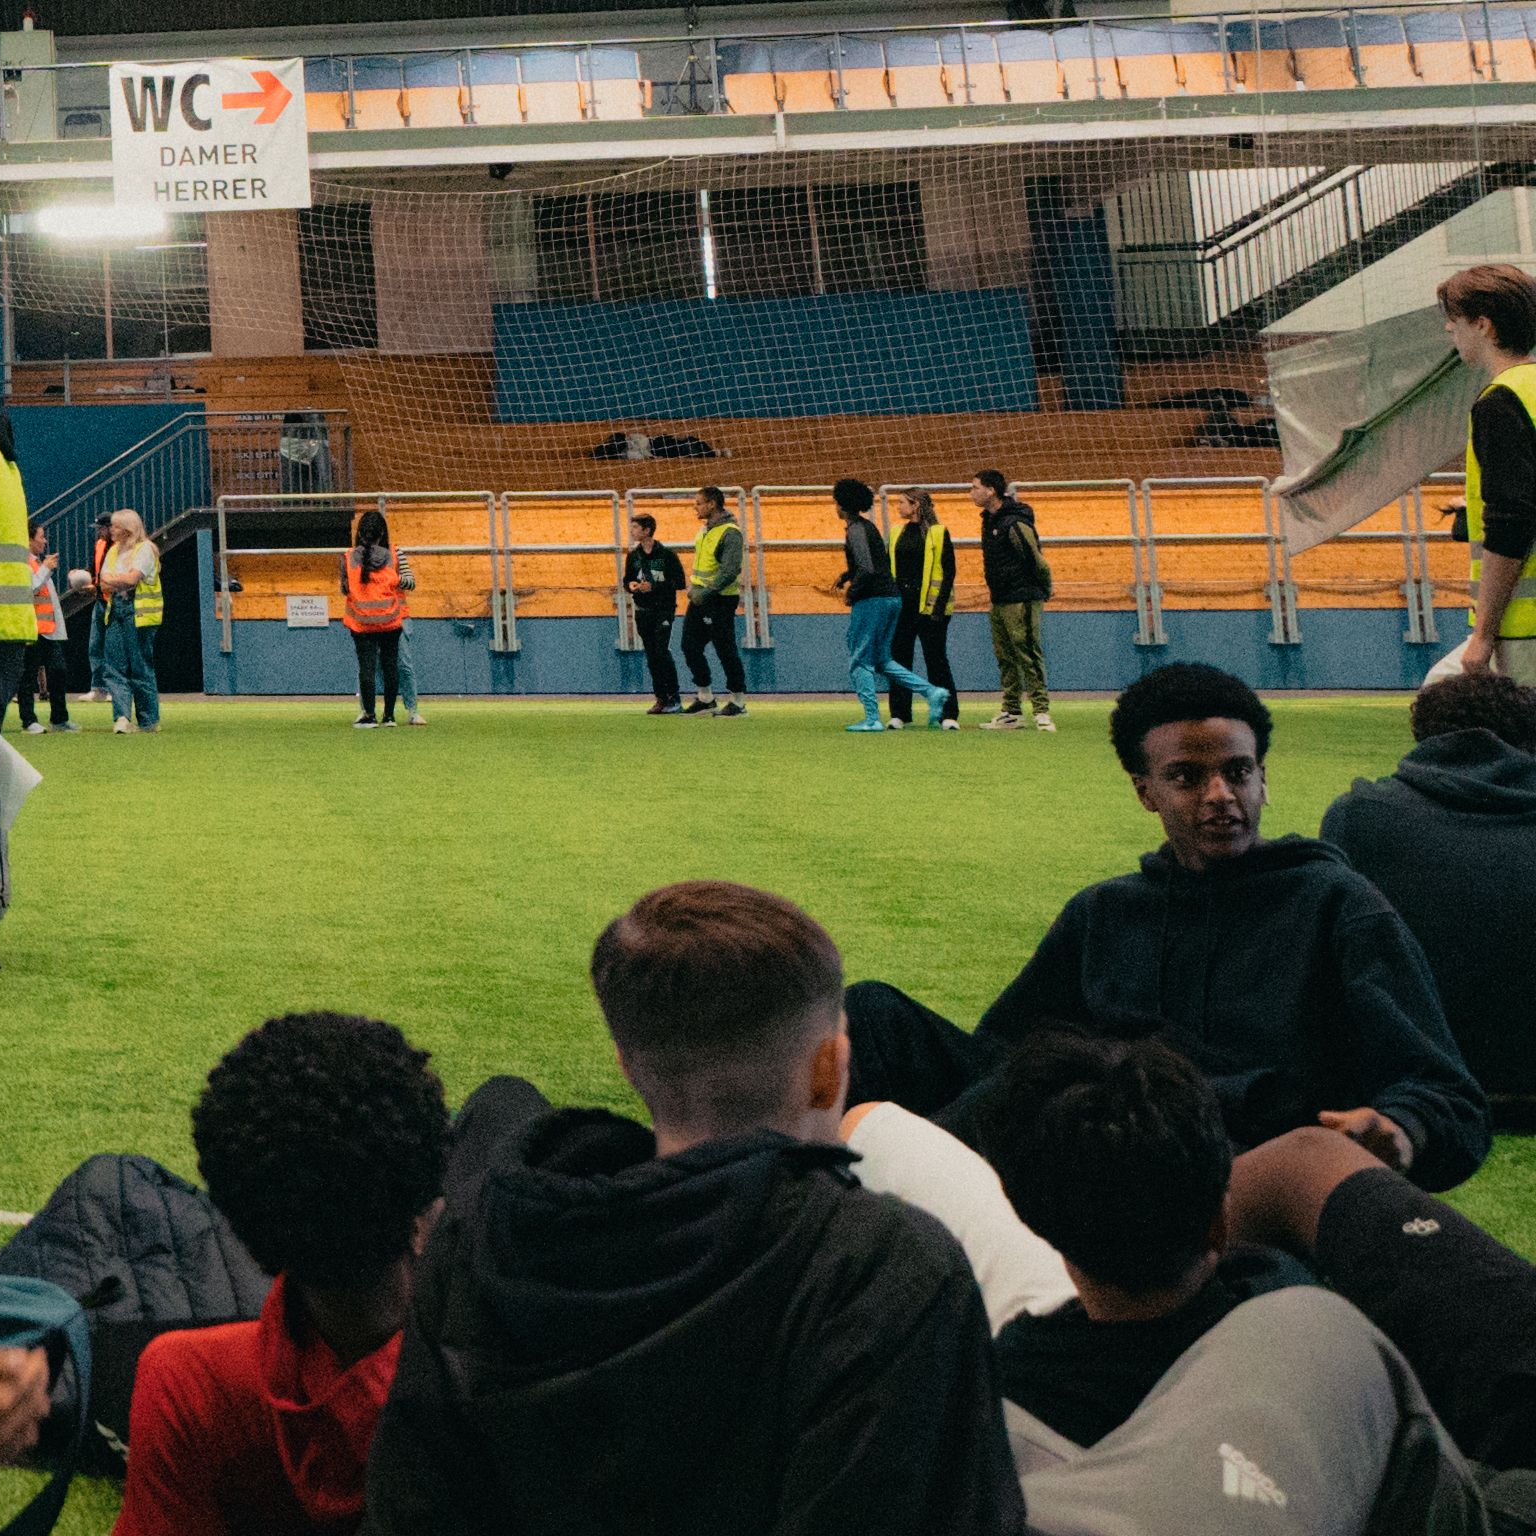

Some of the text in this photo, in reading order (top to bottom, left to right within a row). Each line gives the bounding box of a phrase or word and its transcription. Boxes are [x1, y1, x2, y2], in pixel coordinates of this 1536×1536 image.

[121, 73, 212, 132] WC
[160, 144, 257, 167] DAMER
[154, 178, 268, 202] HERRER
